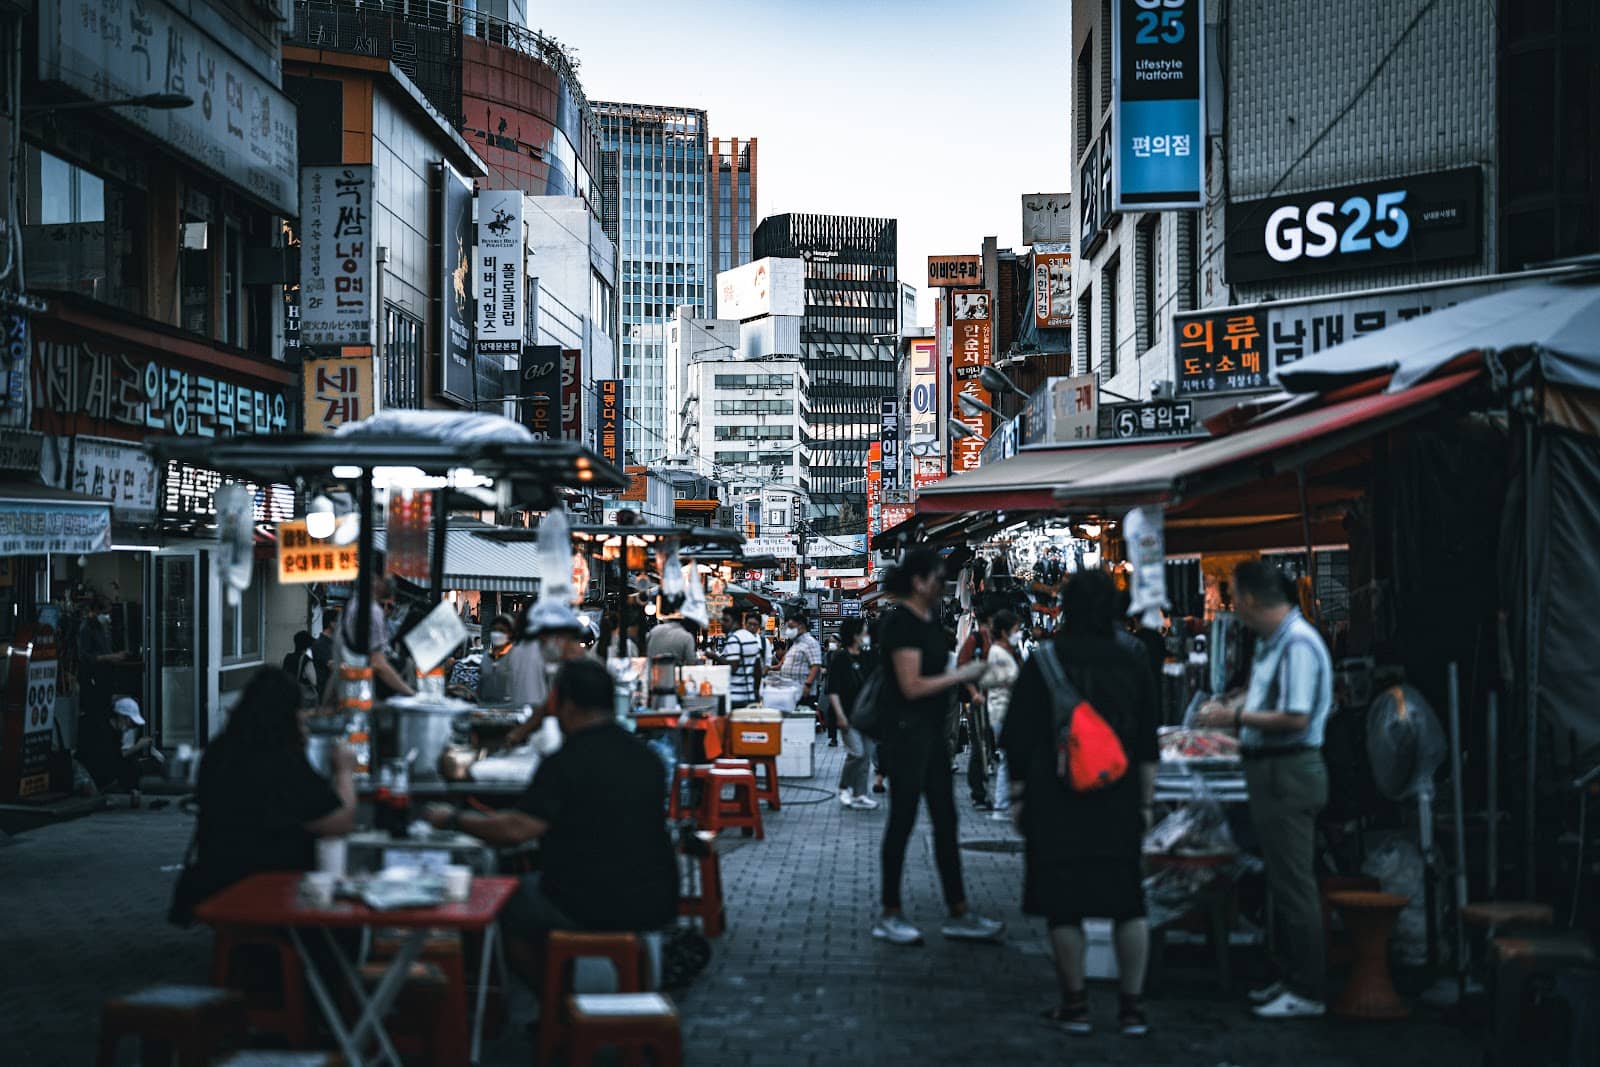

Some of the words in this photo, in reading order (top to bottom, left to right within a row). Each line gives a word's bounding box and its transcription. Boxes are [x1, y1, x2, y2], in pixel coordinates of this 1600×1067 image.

[1135, 10, 1185, 44] 25
[1135, 59, 1183, 71] Lifestyle
[1135, 70, 1184, 81] Platform
[1132, 135, 1191, 157] 편의점
[334, 169, 367, 307] 육쌈냉면
[1264, 189, 1411, 262] GS25
[930, 261, 977, 280] 이비인후과
[308, 298, 323, 309] 2F
[483, 256, 497, 333] 비버리힐즈
[501, 263, 515, 326] 폴로클럽
[1037, 268, 1047, 316] 착한가격
[480, 342, 518, 351] 남대문본점
[1180, 315, 1260, 353] 의류
[1120, 413, 1134, 437] 5
